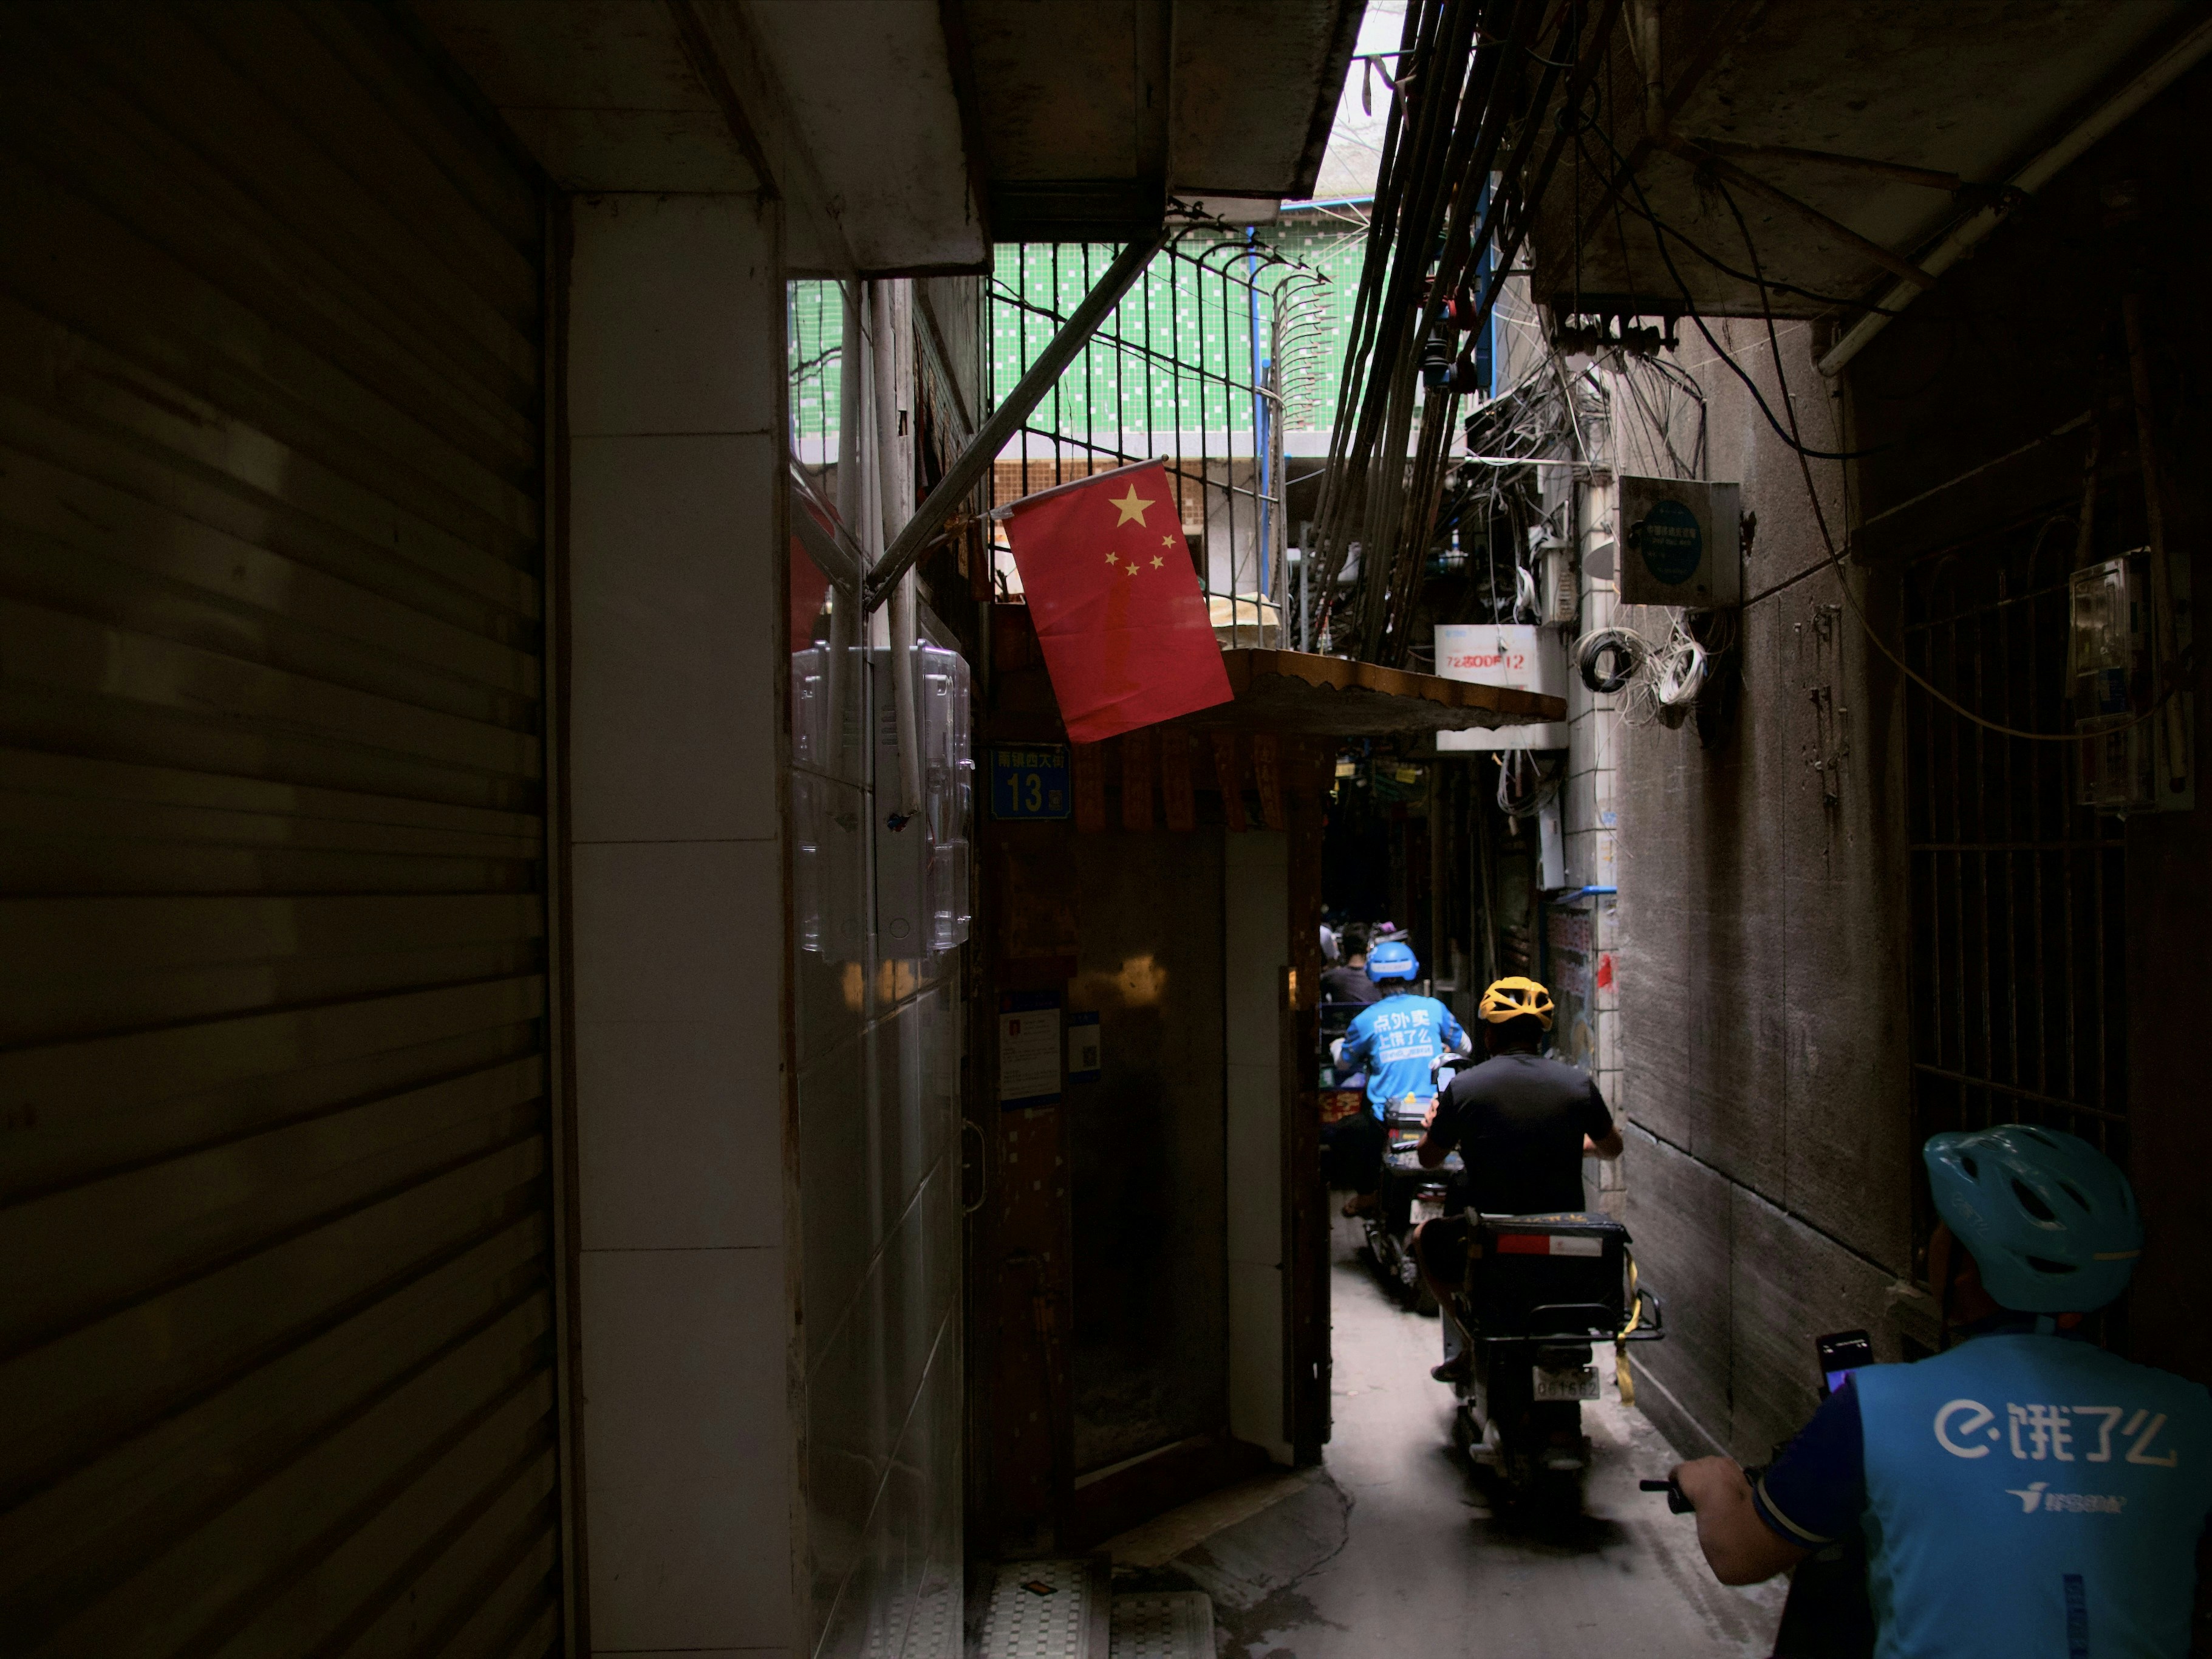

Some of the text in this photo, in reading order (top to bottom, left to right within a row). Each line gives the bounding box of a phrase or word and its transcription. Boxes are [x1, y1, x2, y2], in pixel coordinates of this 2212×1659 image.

[1007, 773, 1042, 812] 13
[1374, 1010, 1430, 1033] 点外卖
[1379, 1028, 1432, 1050] 上饿了么
[2006, 1402, 2178, 1468] 饿了么
